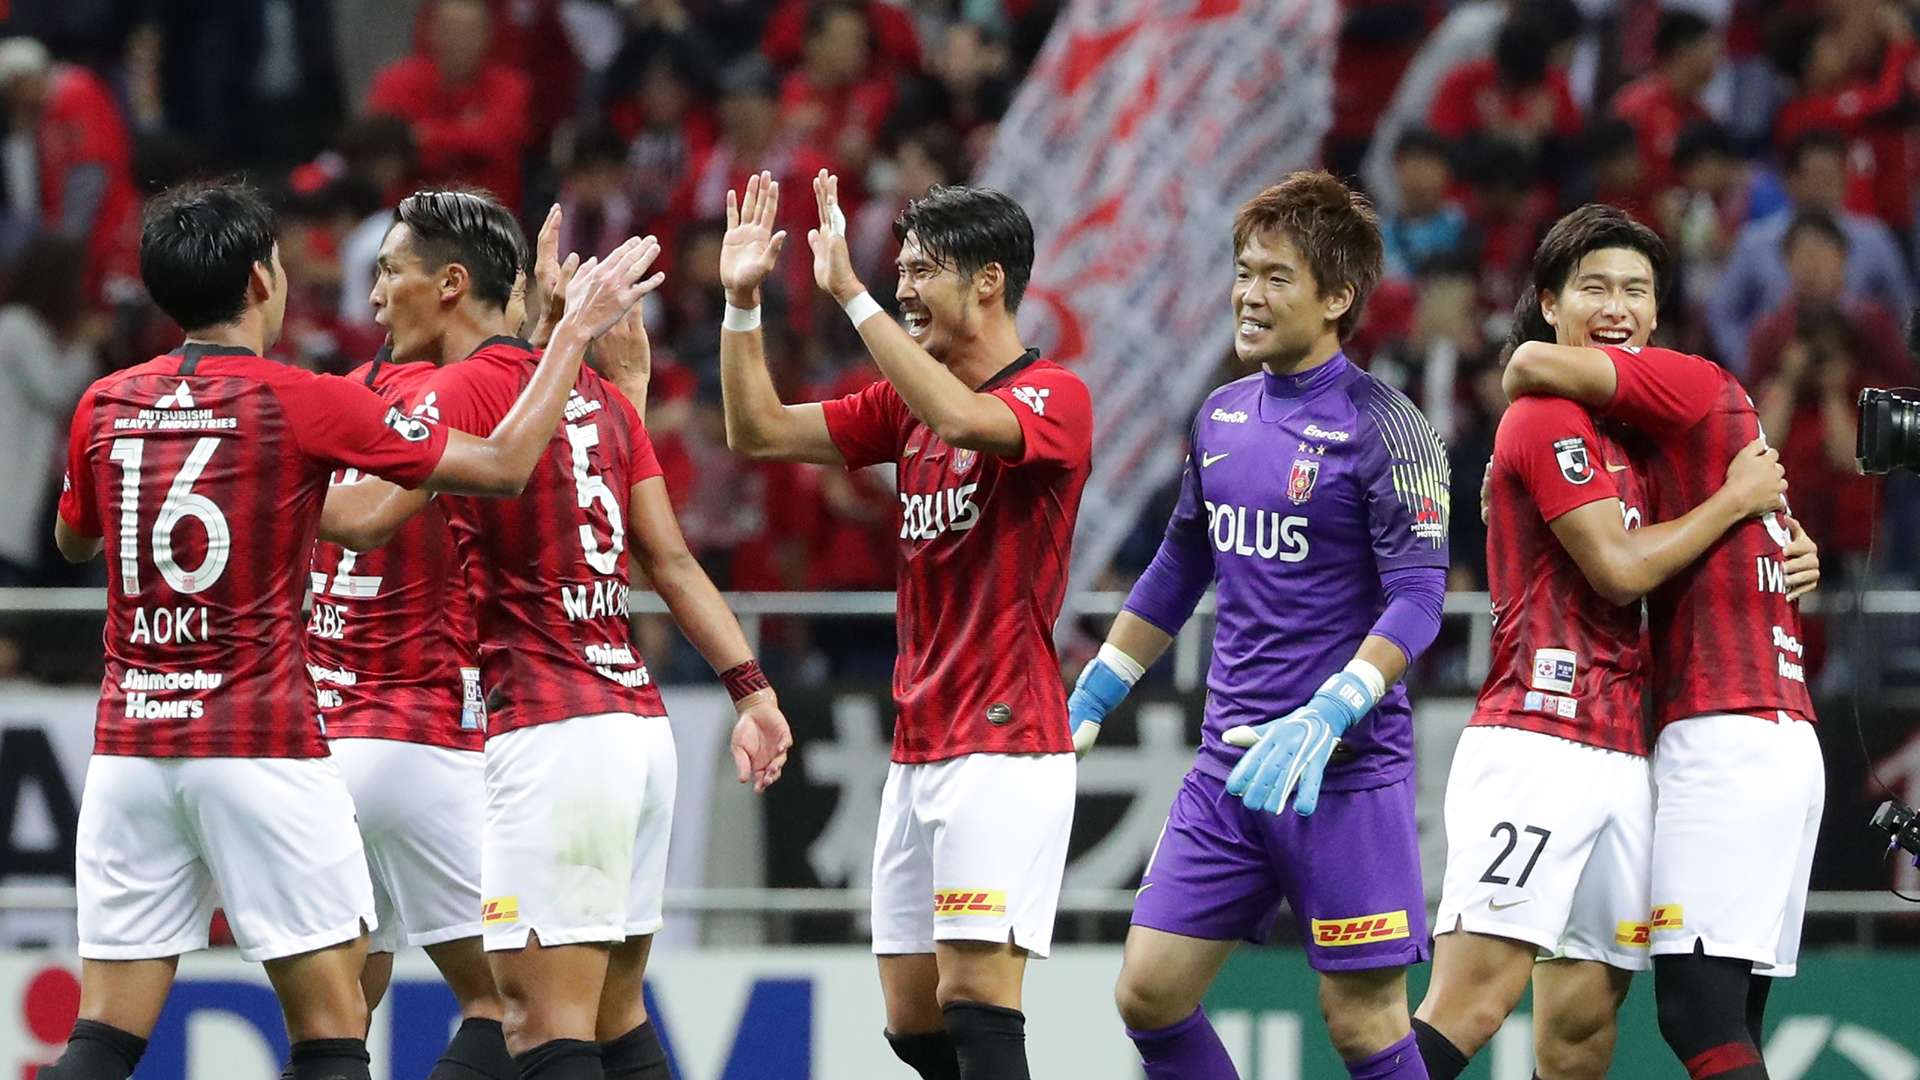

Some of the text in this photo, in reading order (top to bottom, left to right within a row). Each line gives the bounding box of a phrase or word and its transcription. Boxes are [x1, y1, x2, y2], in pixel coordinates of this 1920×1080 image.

[114, 418, 237, 429] HEAVY INDUSTRIES
[138, 409, 213, 420] MITSUBISHI
[565, 423, 624, 575] 5
[110, 437, 230, 594] 16
[130, 607, 208, 644] AOKI
[120, 668, 222, 689] Shimachu
[125, 692, 204, 719] HOME'S
[1479, 821, 1552, 888] 27
[1319, 918, 1394, 942] DHL
